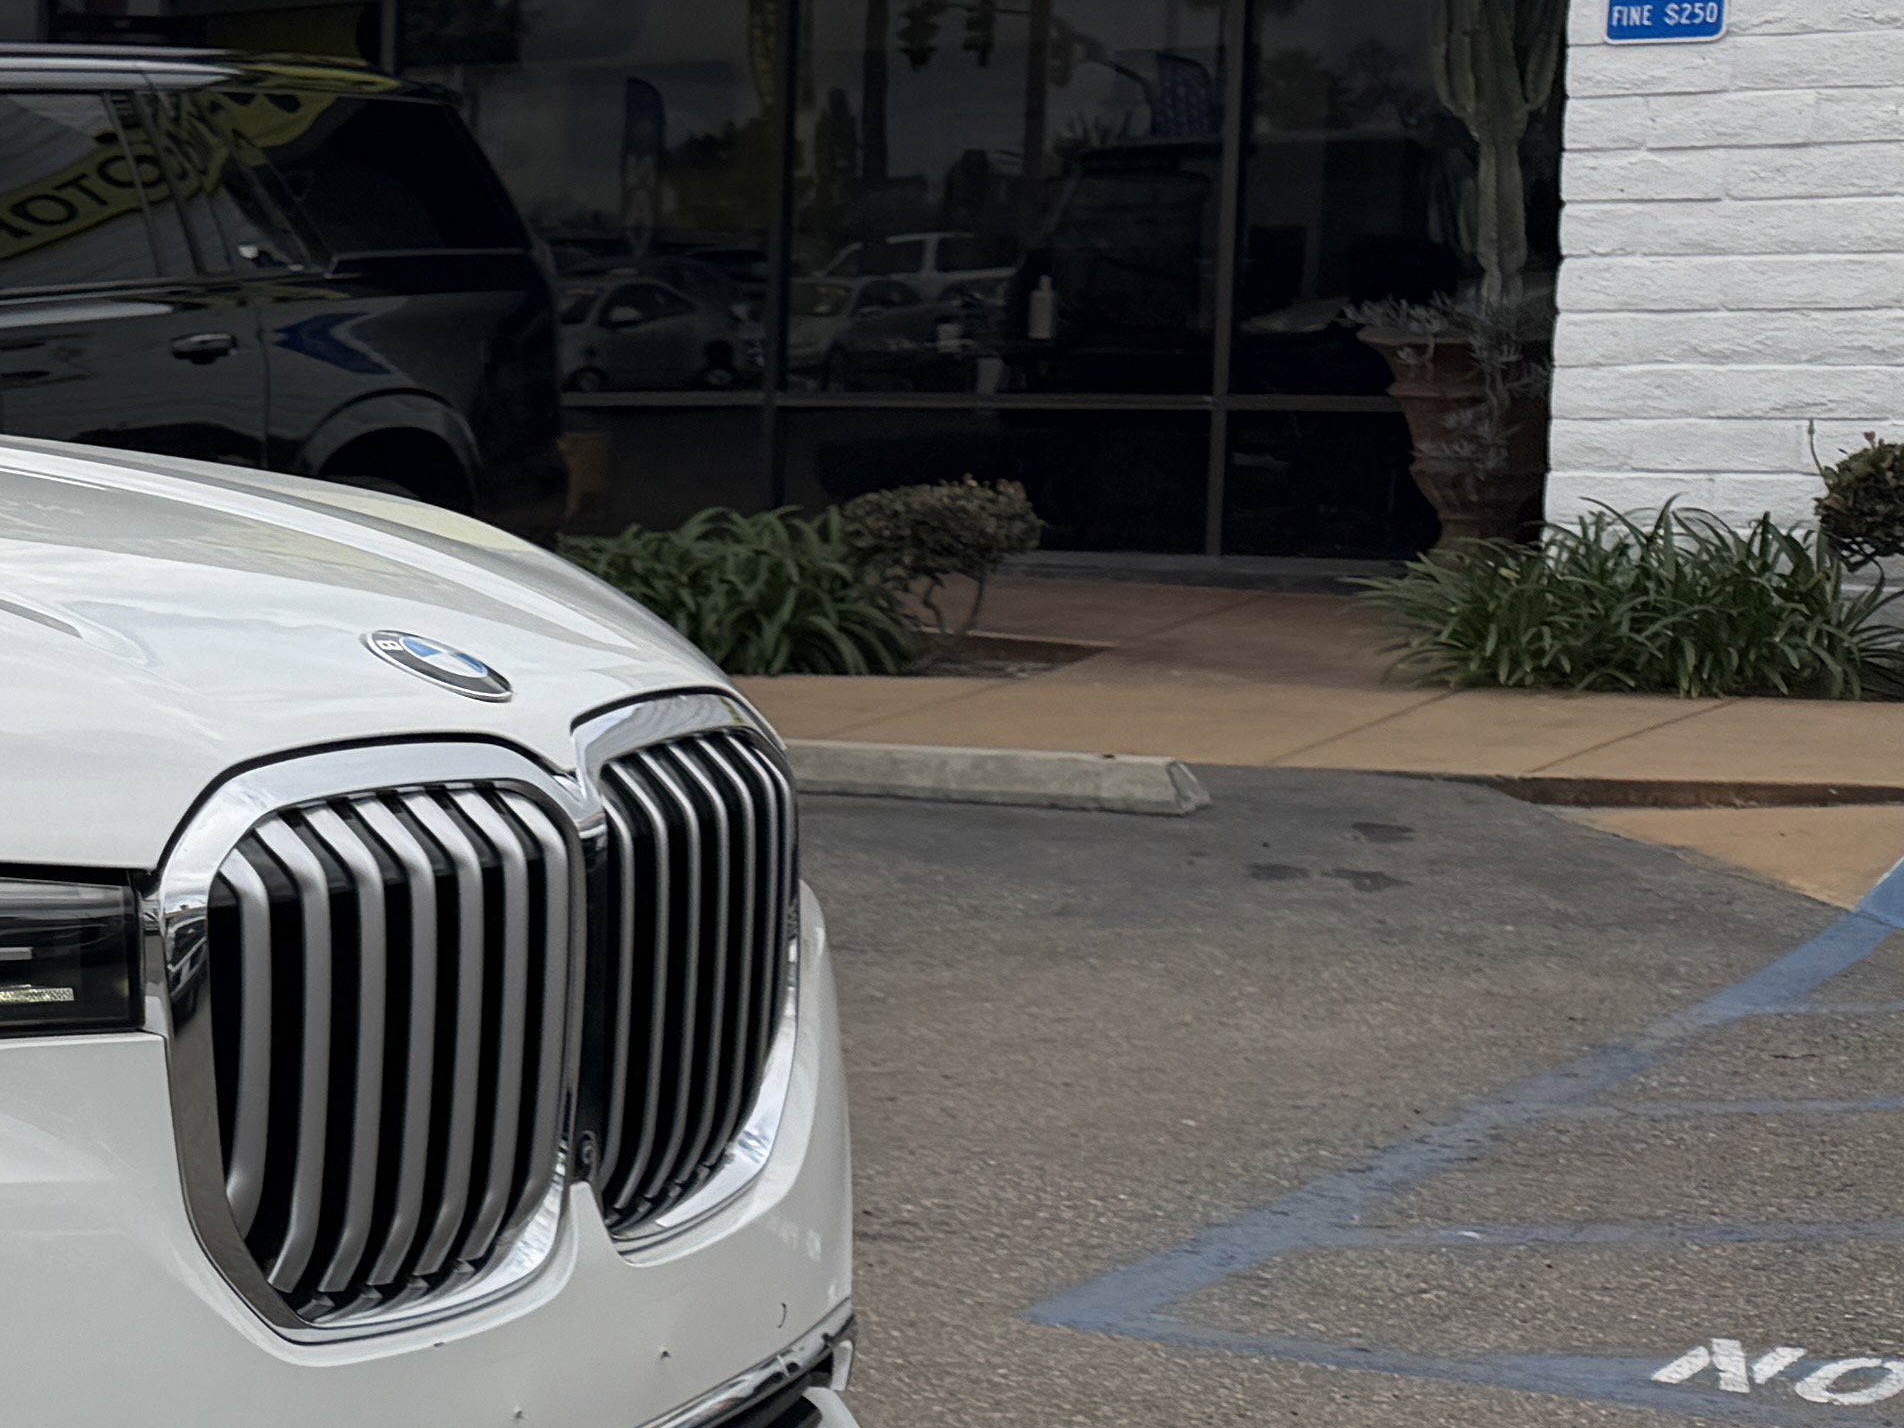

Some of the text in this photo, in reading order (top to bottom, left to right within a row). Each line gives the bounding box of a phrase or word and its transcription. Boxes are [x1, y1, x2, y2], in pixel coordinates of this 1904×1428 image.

[1611, 1, 1719, 27] FINE $250
[1650, 1337, 1904, 1406] NO
